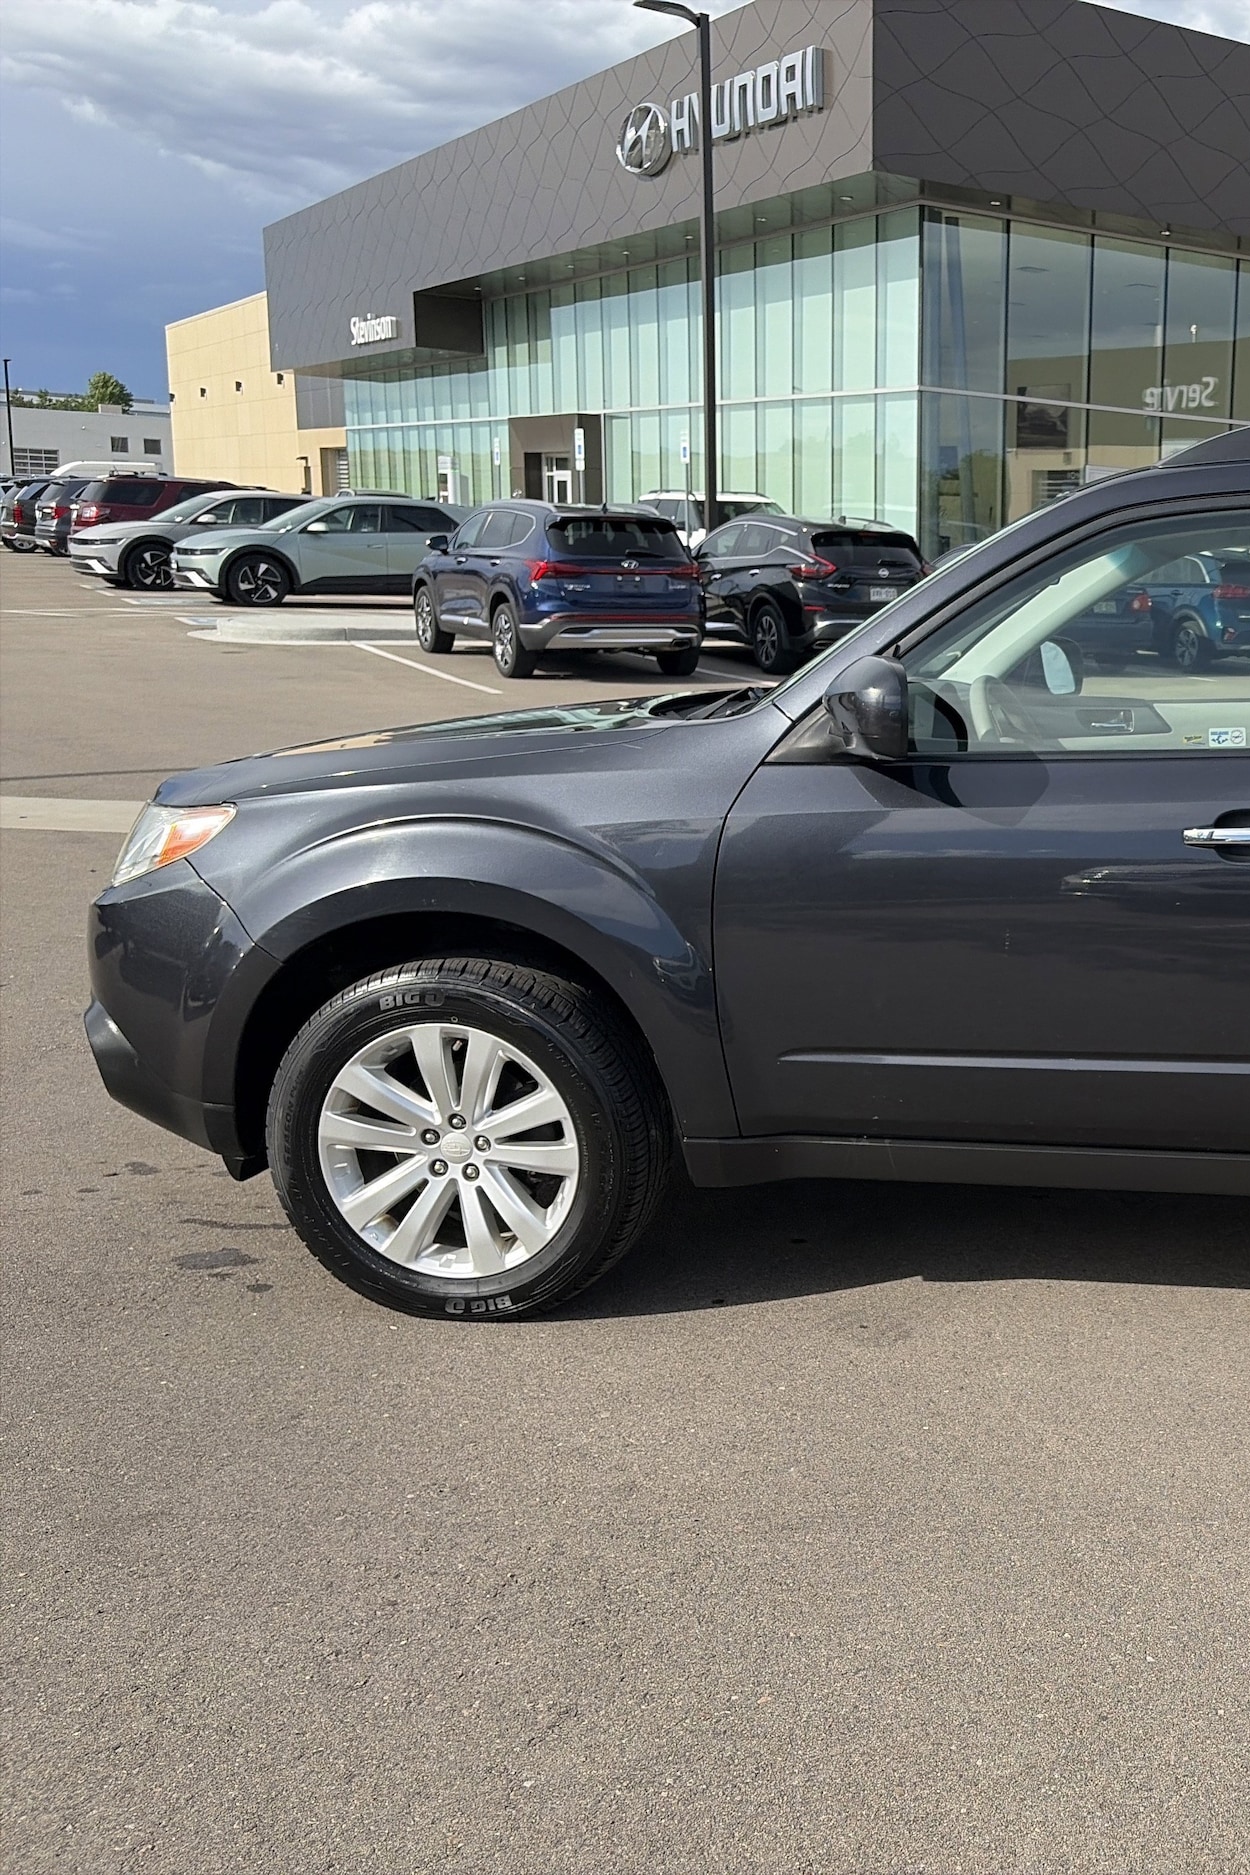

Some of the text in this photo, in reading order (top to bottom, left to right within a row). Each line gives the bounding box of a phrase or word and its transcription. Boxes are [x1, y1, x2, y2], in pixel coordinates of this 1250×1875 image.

[351, 313, 396, 345] Stevinson
[379, 991, 420, 1011] BIG
[470, 1295, 512, 1314] BIG
